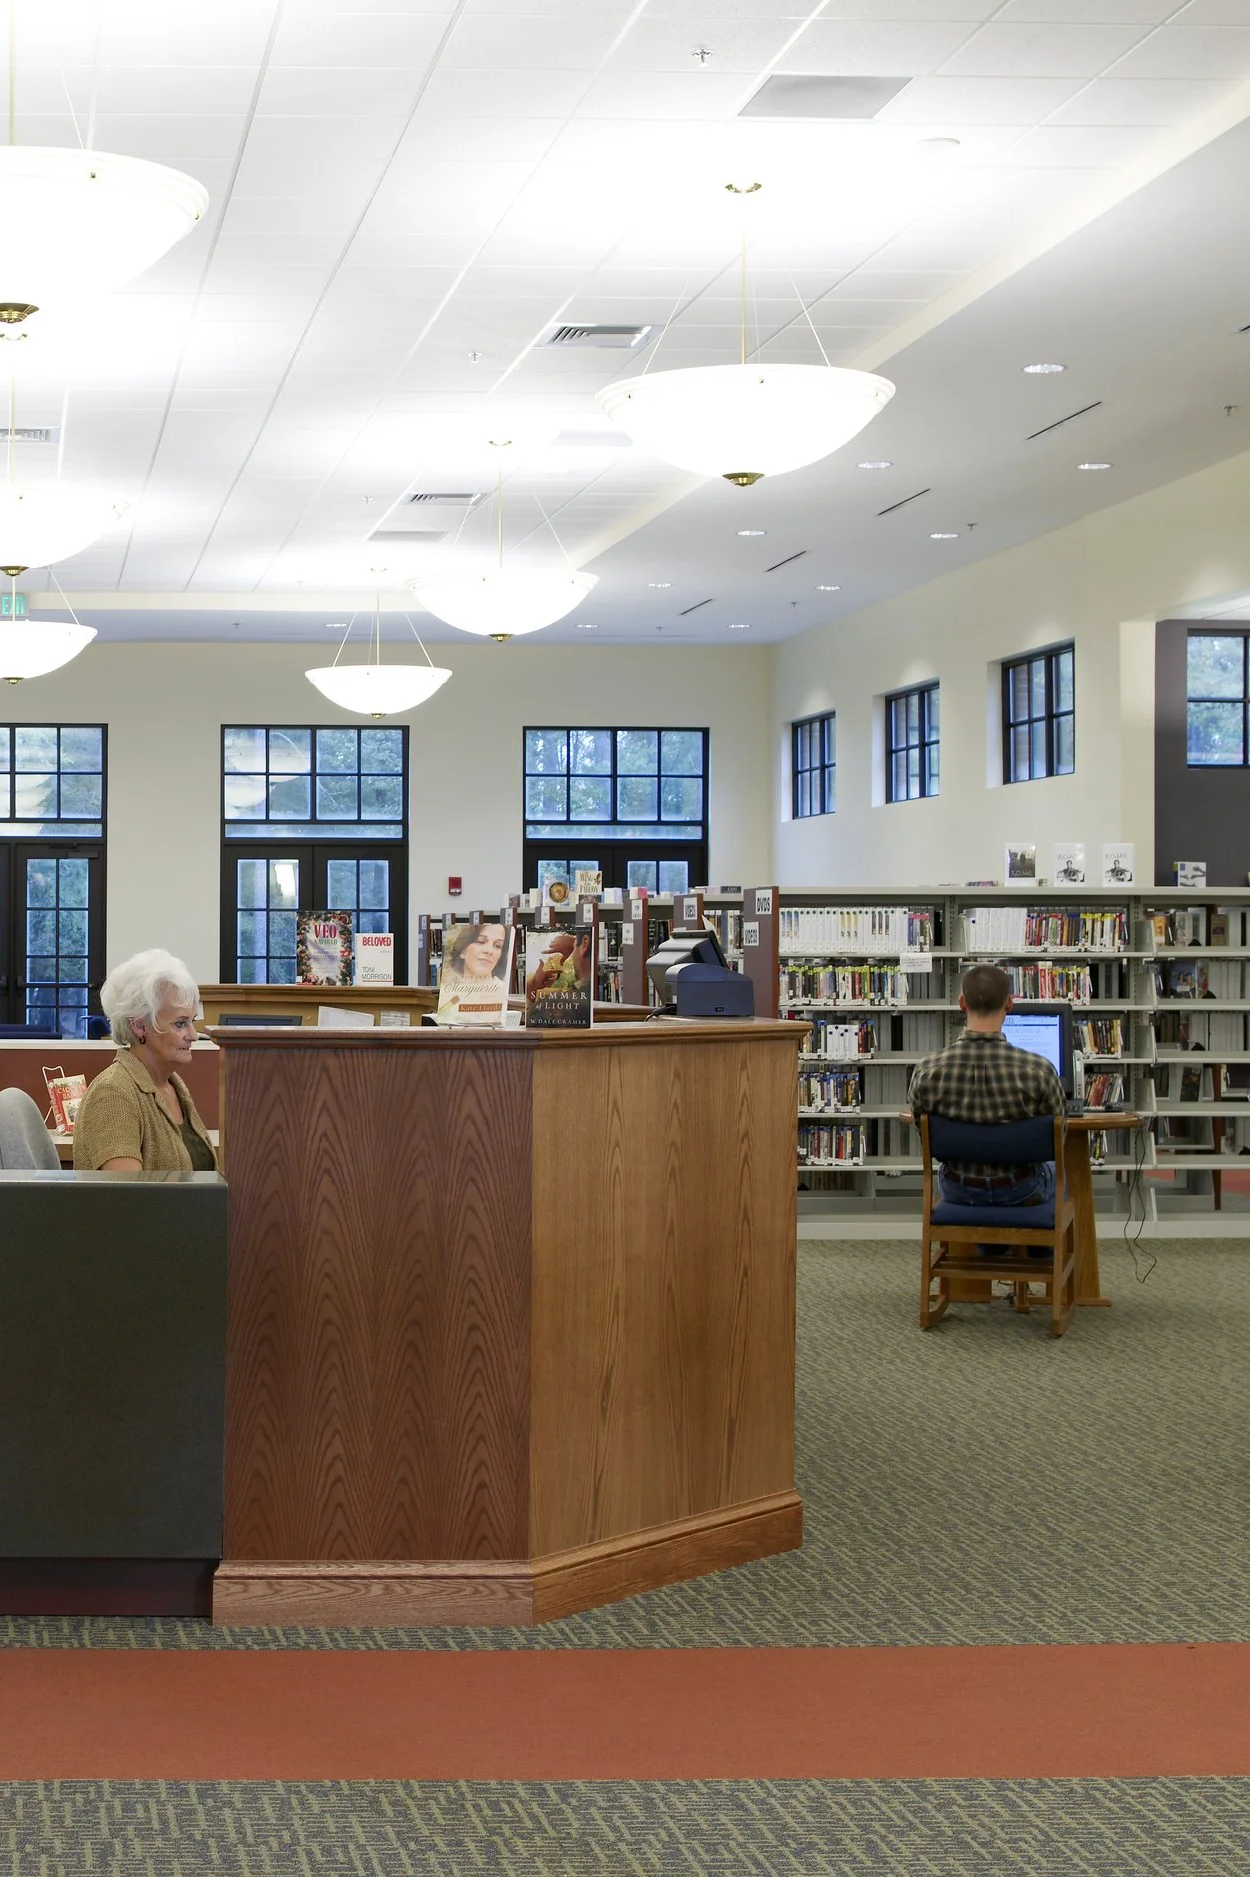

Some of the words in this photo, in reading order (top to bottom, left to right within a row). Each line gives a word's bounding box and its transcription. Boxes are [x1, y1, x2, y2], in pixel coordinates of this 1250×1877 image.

[362, 936, 392, 946] BELOVED
[530, 991, 588, 1000] SUMMER
[545, 1002, 580, 1010] LIGHT
